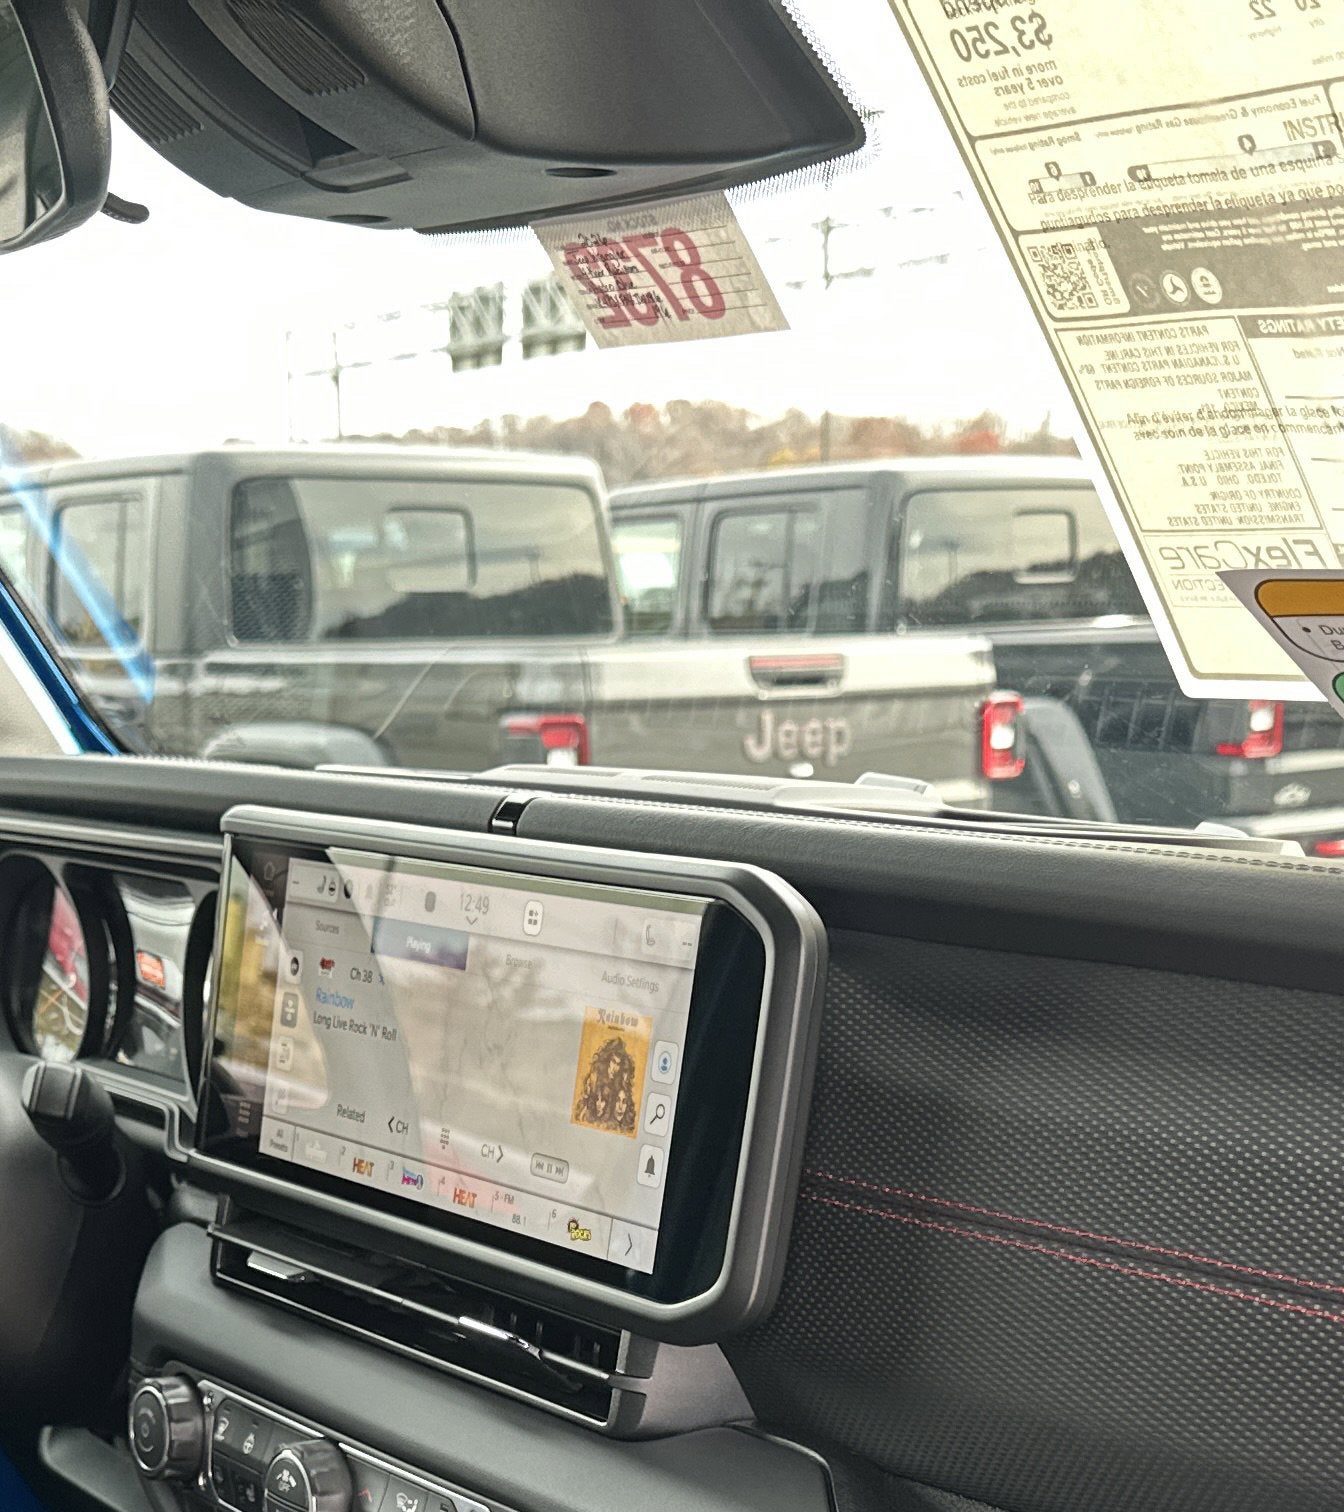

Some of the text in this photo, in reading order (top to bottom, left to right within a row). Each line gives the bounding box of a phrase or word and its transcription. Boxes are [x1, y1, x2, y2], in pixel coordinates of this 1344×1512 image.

[744, 710, 851, 766] Jeep
[460, 893, 490, 916] 12:49
[602, 971, 625, 987] Audio
[315, 987, 355, 1010] Rainbow
[313, 1011, 332, 1031] Long
[332, 1015, 347, 1031] Live
[348, 1019, 368, 1037] Rock
[382, 1025, 398, 1042] Roll
[395, 1120, 409, 1136] CH
[481, 1143, 495, 1159] CH
[352, 1157, 375, 1178] HEAT
[453, 1187, 478, 1209] HEAT
